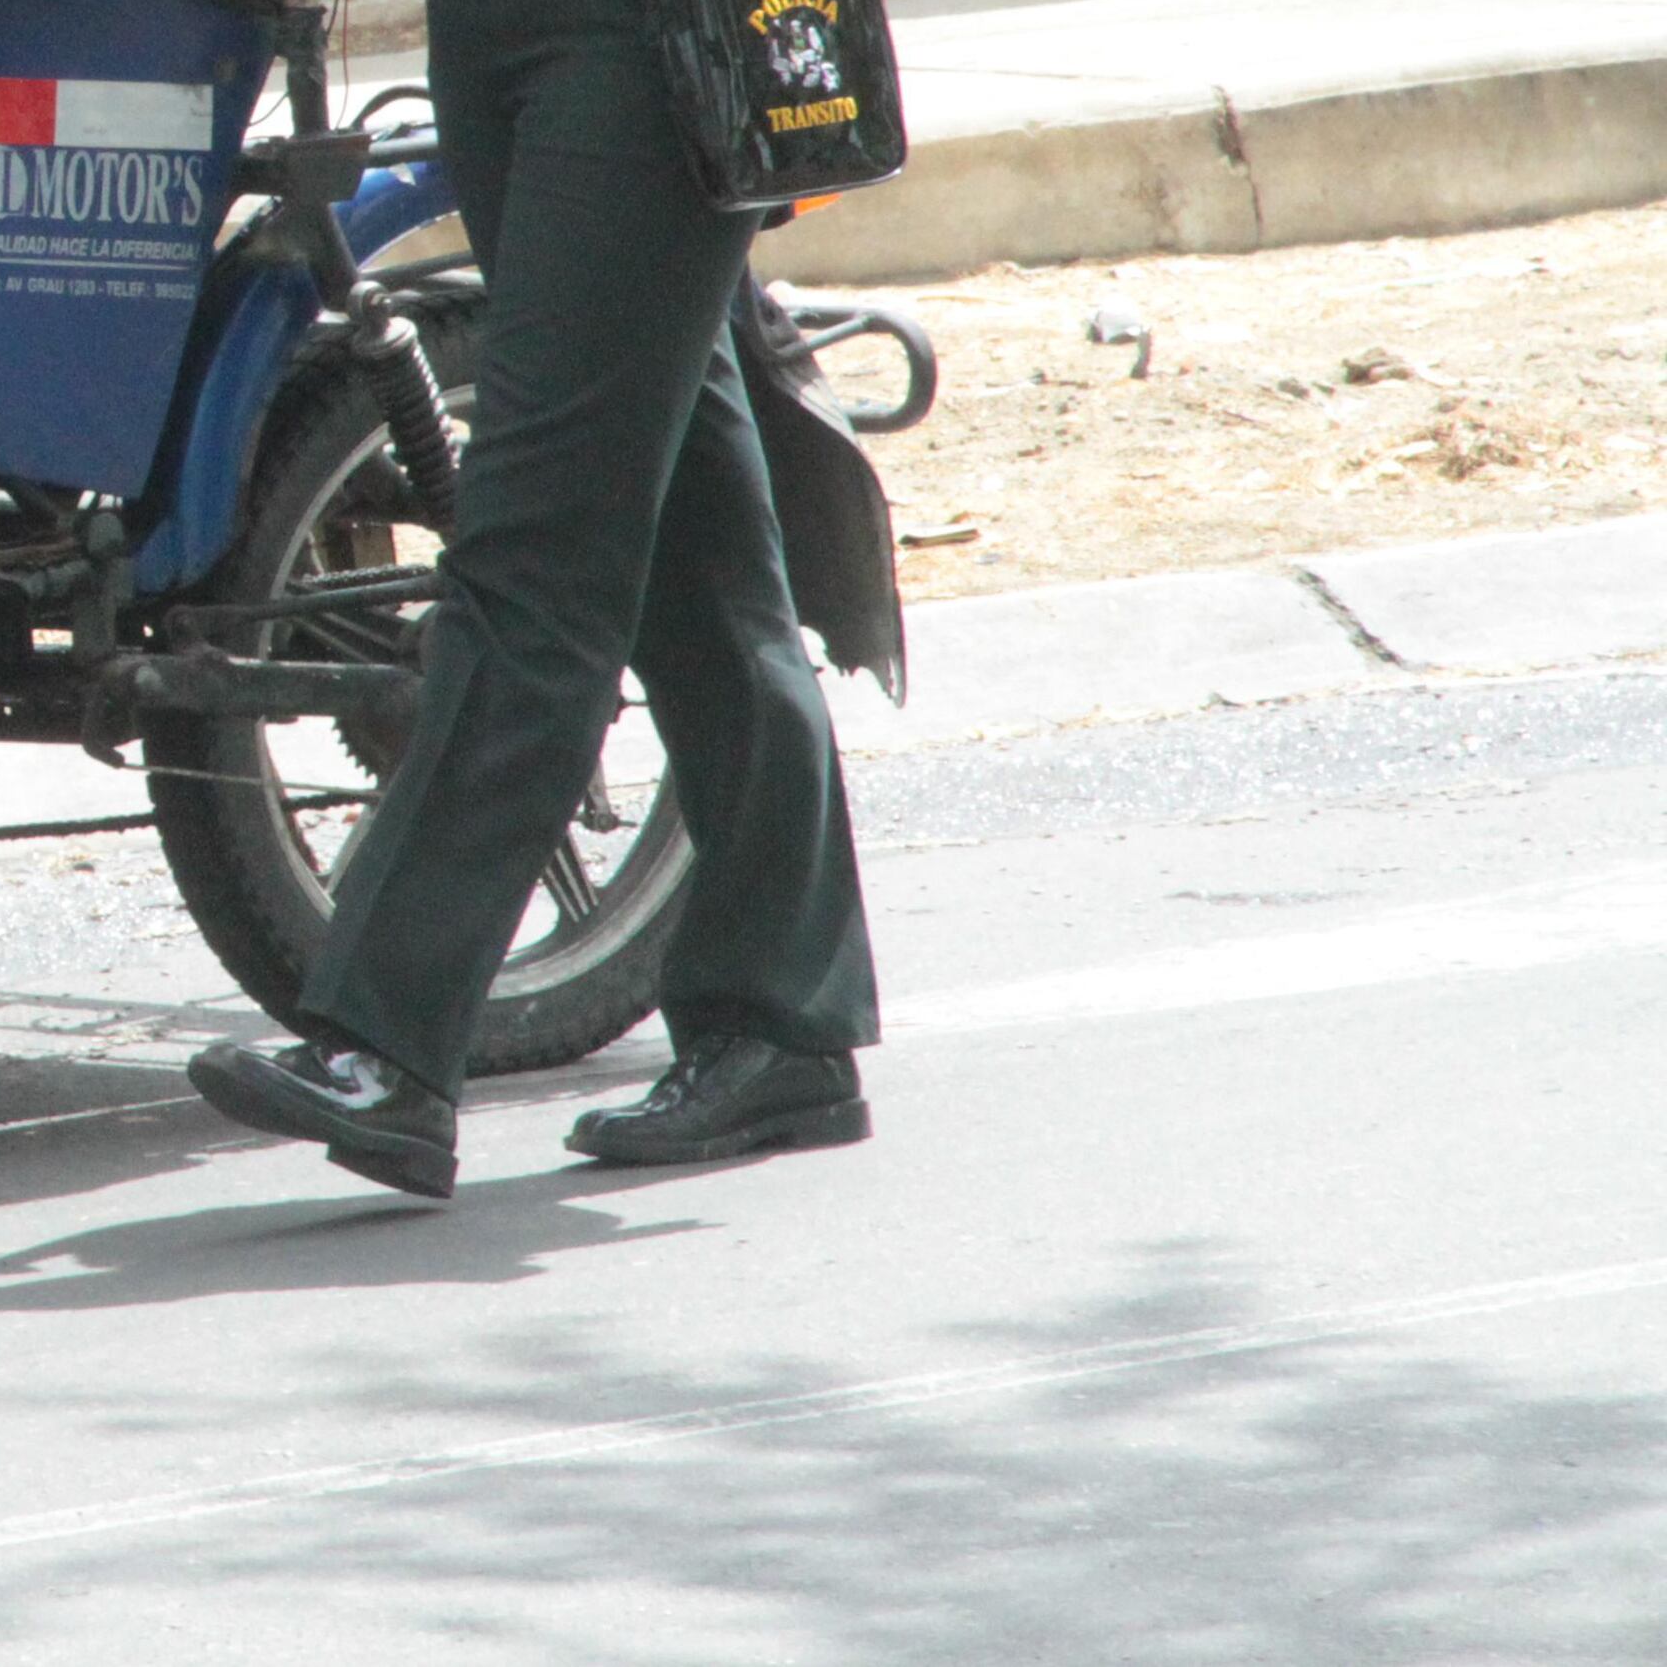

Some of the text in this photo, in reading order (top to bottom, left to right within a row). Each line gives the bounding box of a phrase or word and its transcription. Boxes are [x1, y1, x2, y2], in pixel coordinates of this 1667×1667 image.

[766, 96, 858, 133] TRANSITO
[31, 148, 204, 227] MOTOR'S
[50, 237, 89, 256] HACE
[91, 238, 110, 257] LA
[27, 277, 66, 295] GRAU
